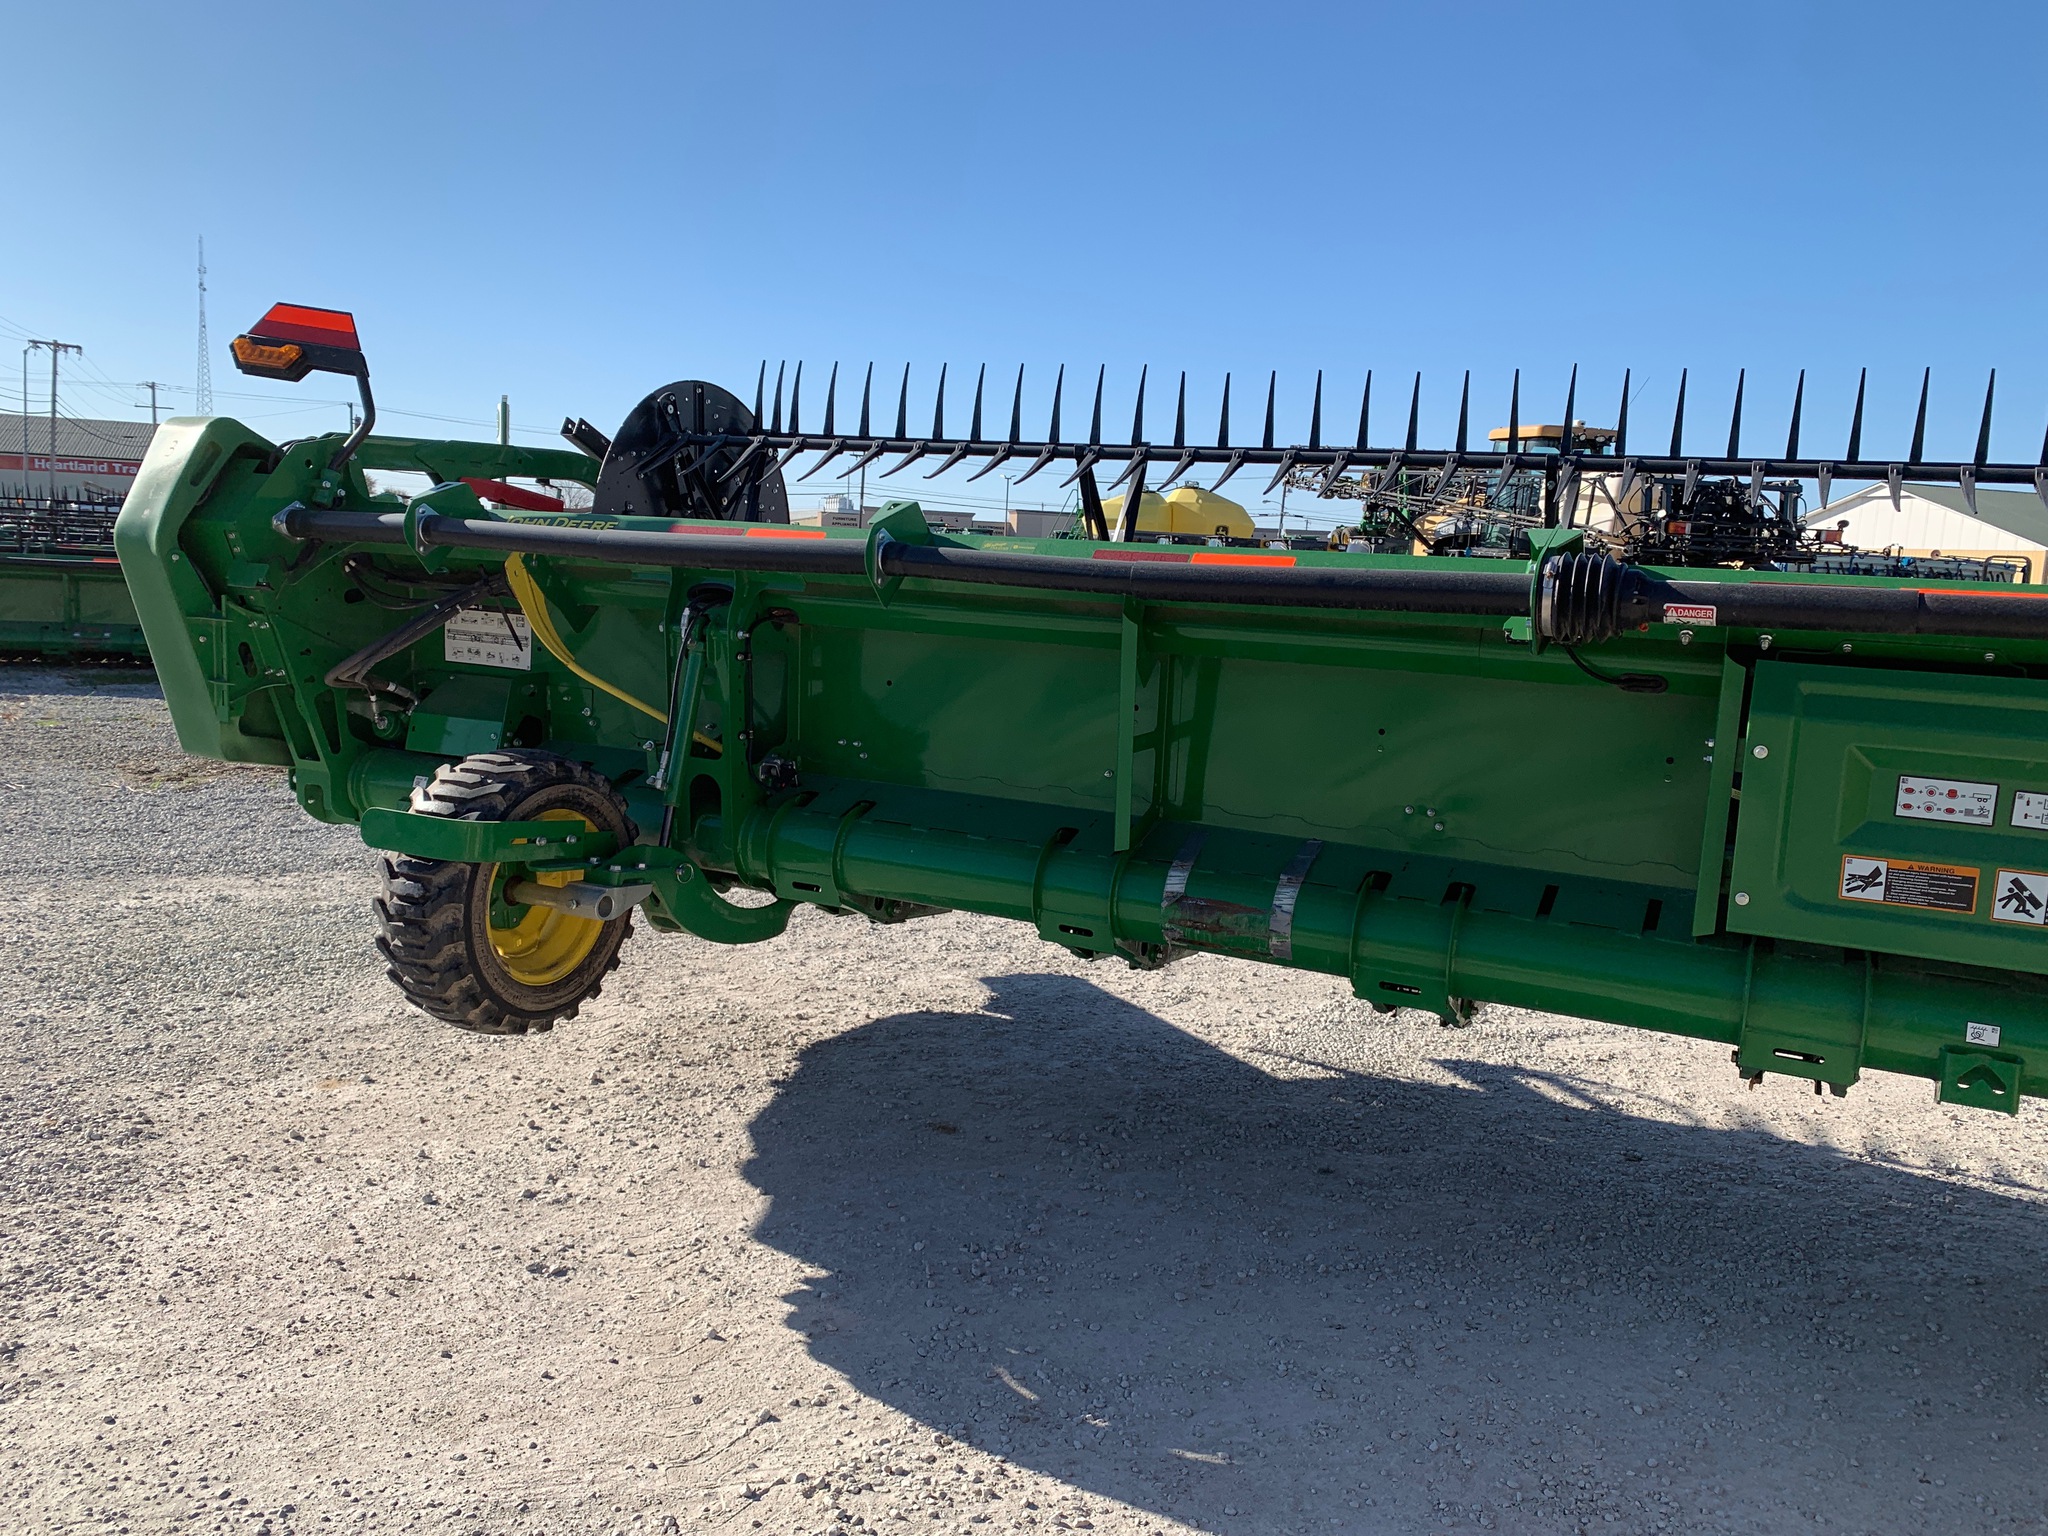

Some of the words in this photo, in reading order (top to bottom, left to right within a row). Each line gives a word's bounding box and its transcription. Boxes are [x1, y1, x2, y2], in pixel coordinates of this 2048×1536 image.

[34, 458, 108, 473] Heartland
[1677, 608, 1713, 618] DANGER
[1917, 864, 1956, 875] WARNING
